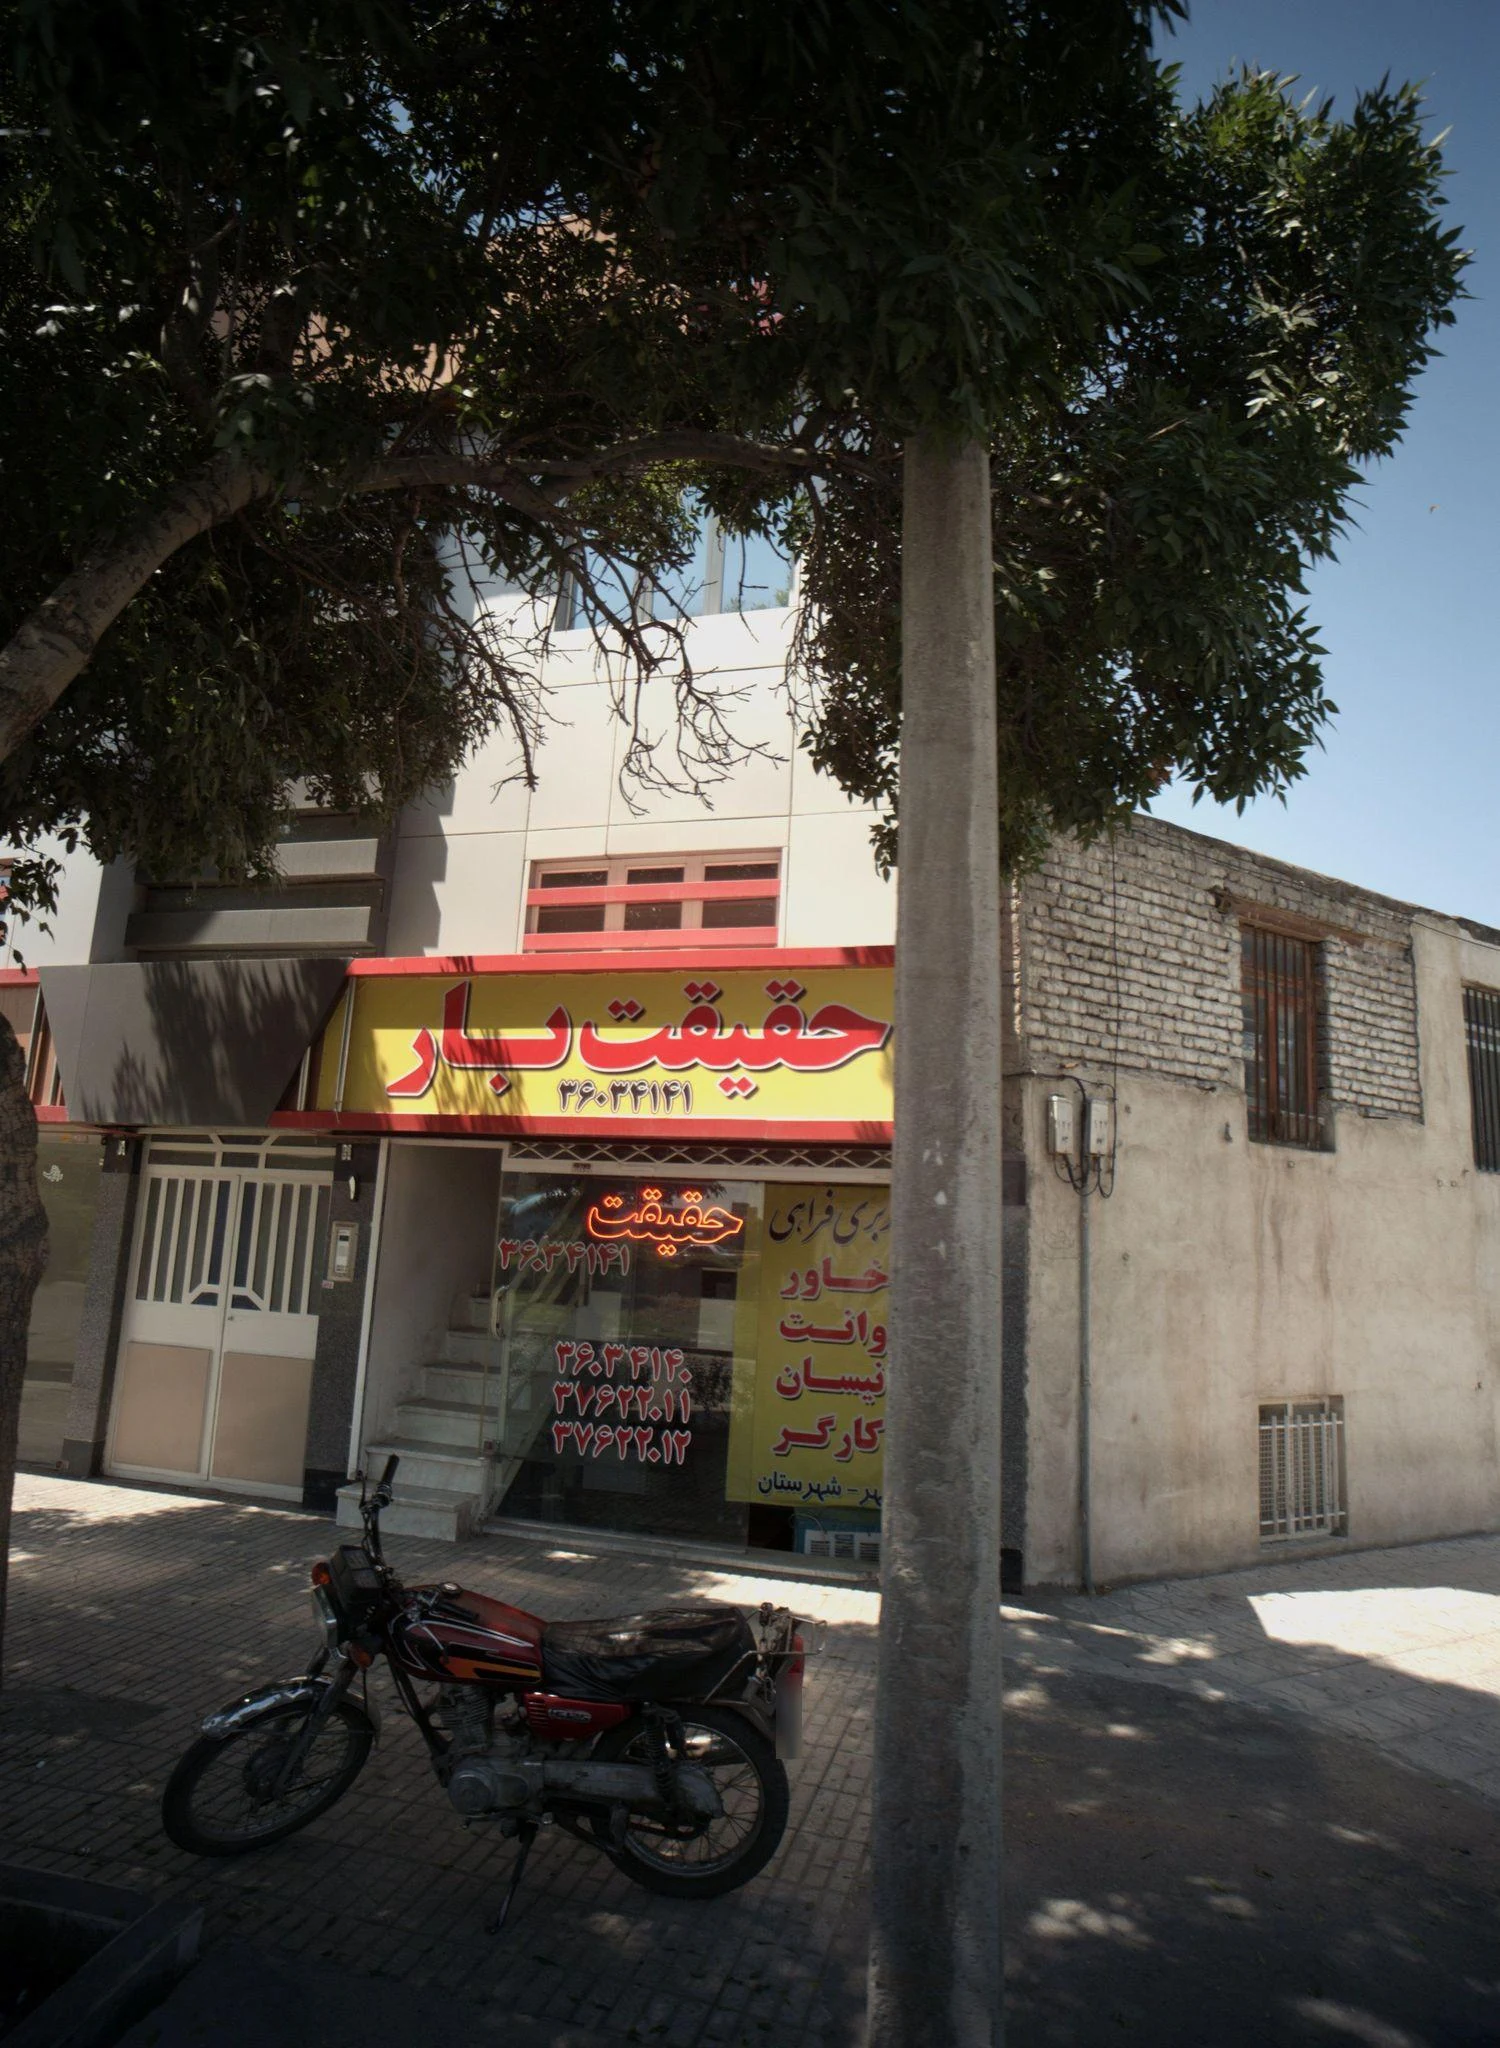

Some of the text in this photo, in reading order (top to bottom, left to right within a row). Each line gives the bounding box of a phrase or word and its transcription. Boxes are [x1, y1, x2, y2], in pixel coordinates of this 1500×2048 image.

[386, 979, 892, 1099] حقیقت بار
[558, 1079, 693, 1114] ۳۶۰۳۴۱۴۱
[587, 1188, 744, 1257] حقیقت
[498, 1238, 631, 1276] ۳۶۰۳۴۱۴۱
[780, 1256, 890, 1300] خاور
[780, 1310, 888, 1356] وانت
[555, 1341, 693, 1383] ۳۶۰۳۴۱۴۰
[774, 1355, 887, 1405] نیسان
[552, 1381, 691, 1423] ۳۷۶۲۲۰۱۱
[552, 1421, 692, 1465] ۳۷۶۲۲۰۱۲
[771, 1415, 886, 1462] کارگر
[758, 1471, 842, 1502] شهرستان
[859, 1487, 883, 1507] هر
